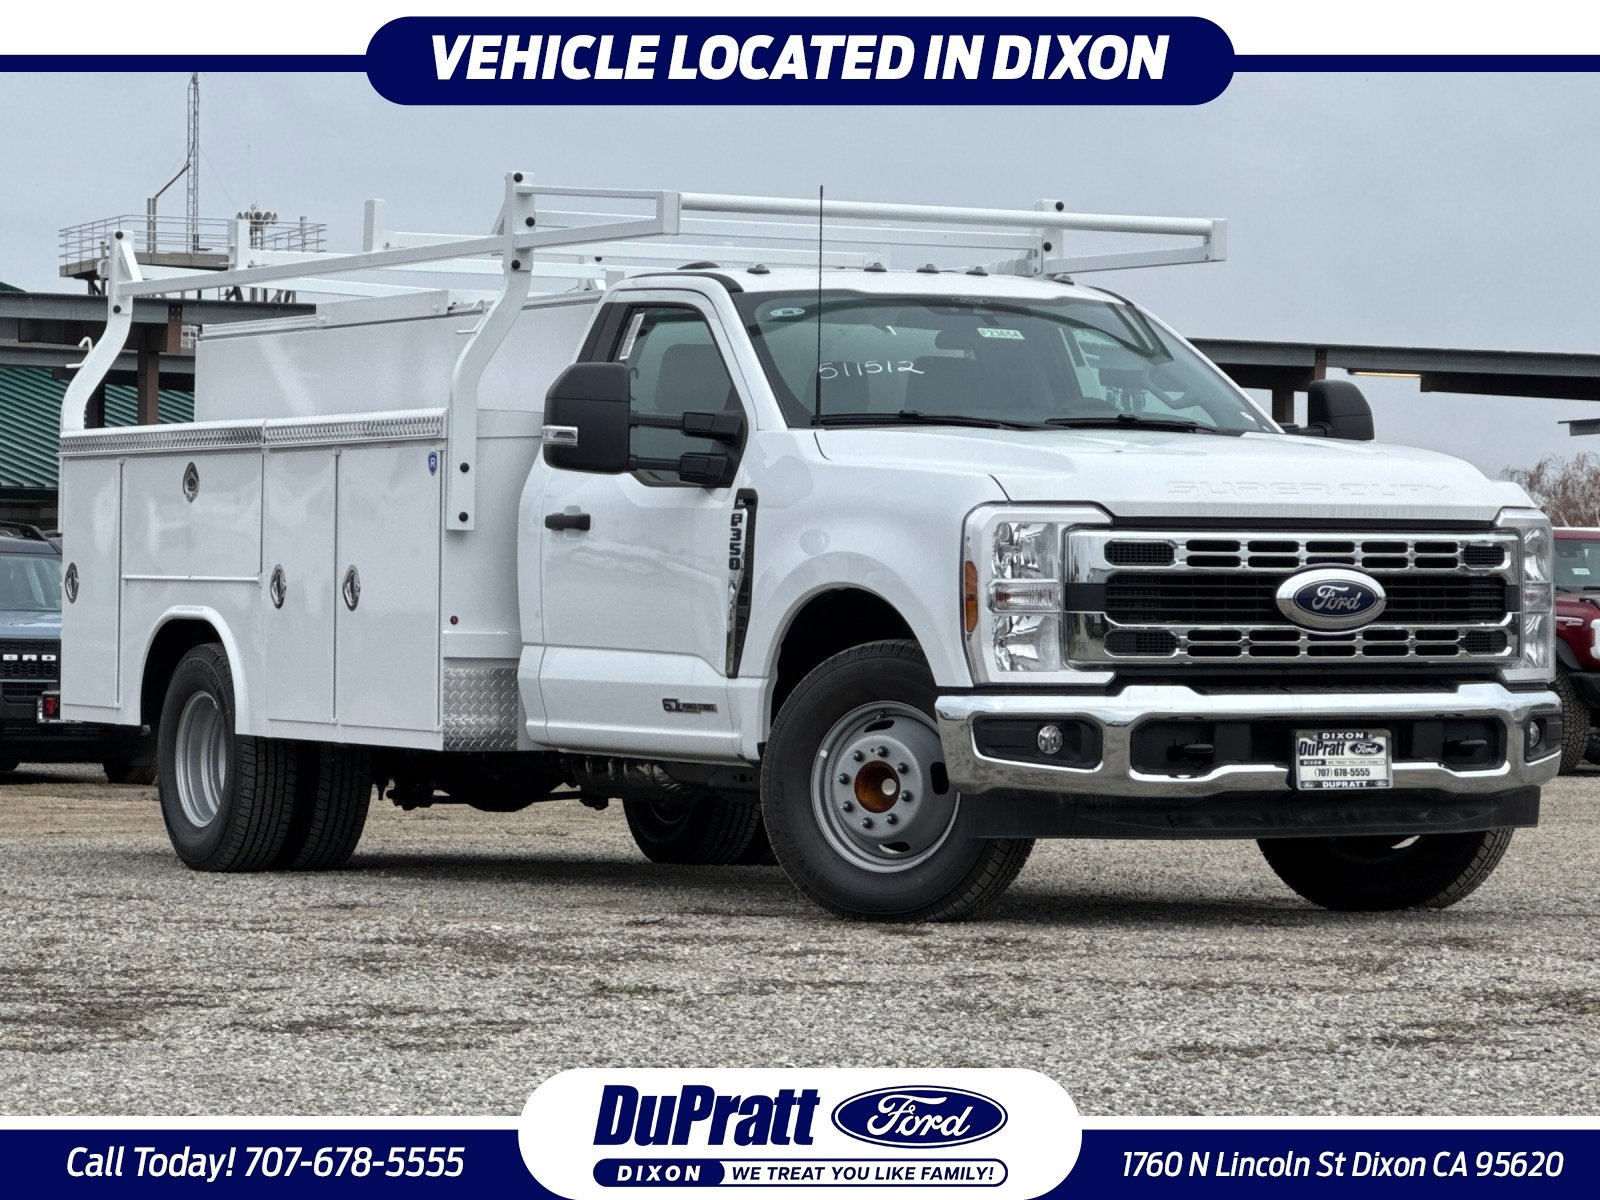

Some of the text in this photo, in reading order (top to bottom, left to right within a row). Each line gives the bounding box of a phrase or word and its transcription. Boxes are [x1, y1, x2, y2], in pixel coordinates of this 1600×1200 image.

[819, 360, 925, 379] 511512
[1167, 480, 1450, 497] SUPER DUTY
[1311, 585, 1362, 610] Ford
[1300, 741, 1345, 756] DuPratt
[1355, 743, 1379, 754] Ford
[1314, 768, 1371, 778] (707) 678-5555
